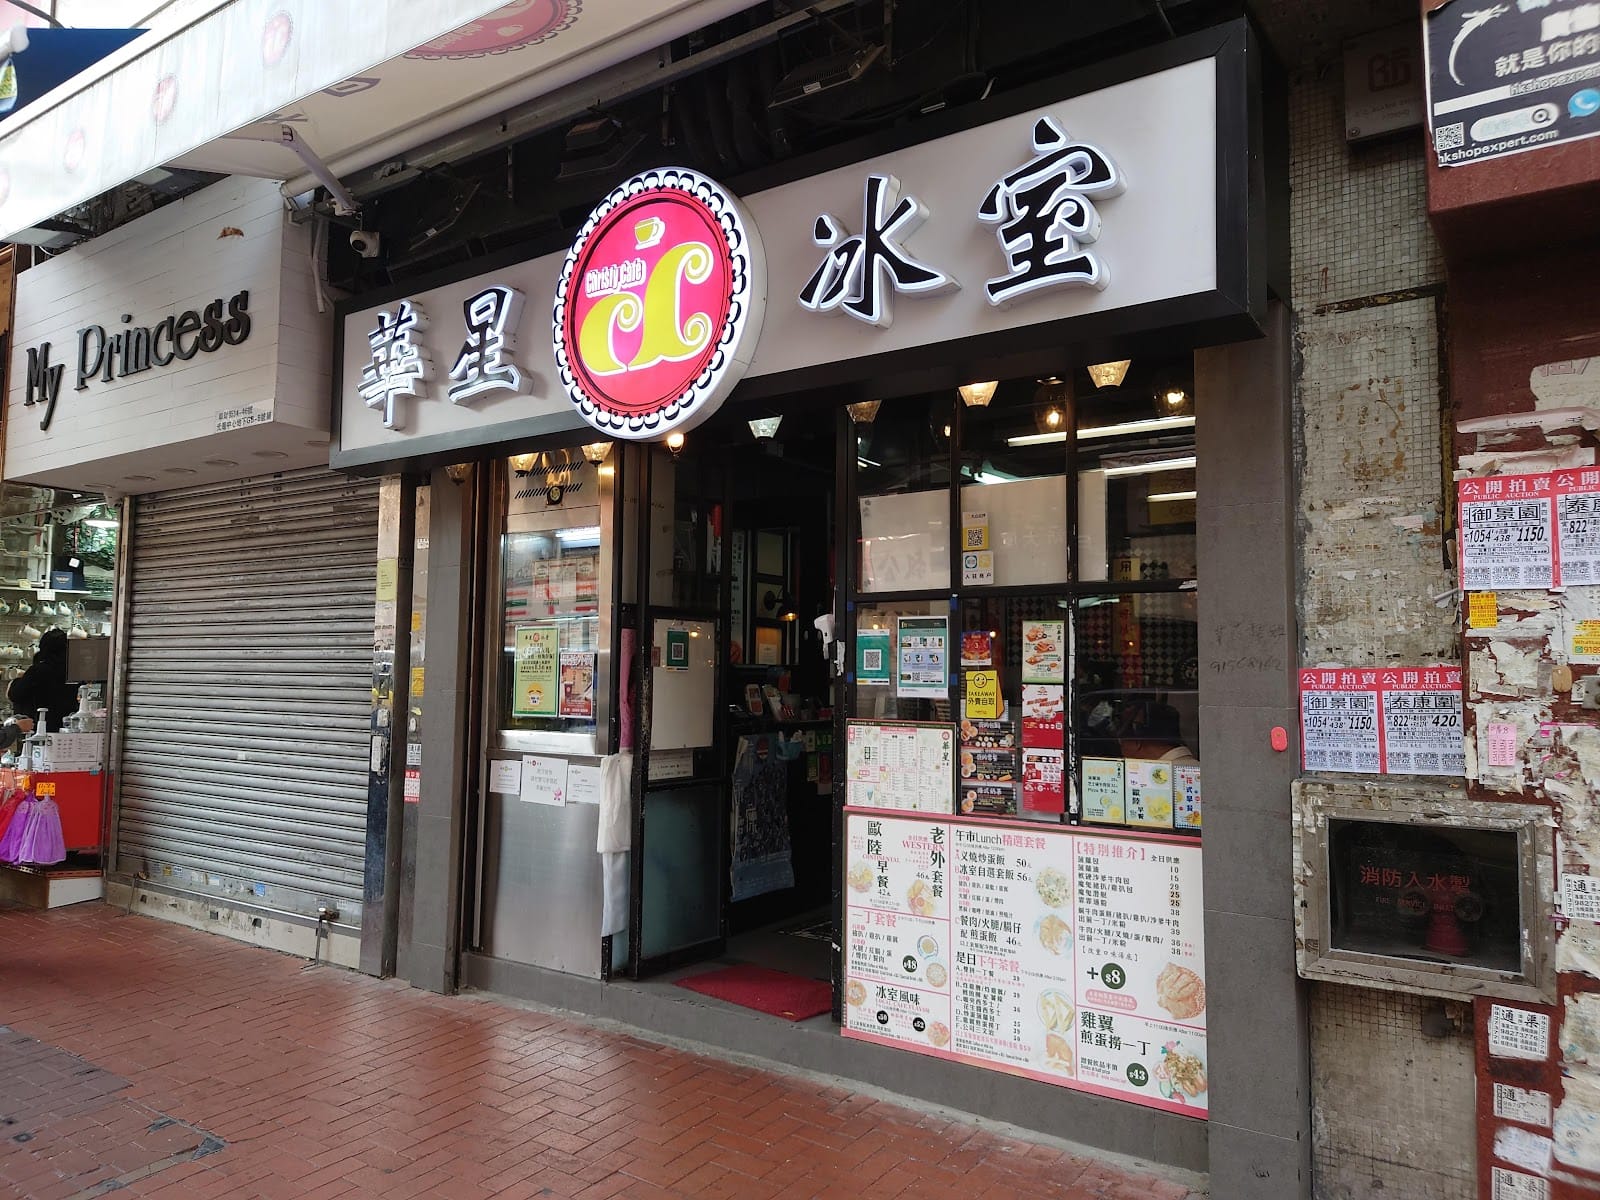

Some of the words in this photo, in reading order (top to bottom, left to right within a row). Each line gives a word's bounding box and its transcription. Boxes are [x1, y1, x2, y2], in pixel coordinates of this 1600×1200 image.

[799, 116, 1122, 324] 冰室
[586, 262, 620, 296] Christy
[24, 342, 64, 431] My
[74, 290, 251, 391] Princess
[357, 286, 532, 429] 華星
[1462, 477, 1551, 495] 公開拍賣
[1471, 506, 1539, 521] 御景園
[1517, 526, 1545, 541] 1150
[1302, 672, 1377, 685] 公開拍賣
[1382, 671, 1462, 685] 公開拍賣
[967, 697, 995, 705] 外賣自取
[1310, 697, 1367, 709] 御景園
[1349, 716, 1372, 730] 1150
[1432, 715, 1457, 727] 420
[902, 840, 945, 852] WESTERN
[1573, 880, 1590, 894] 通
[1170, 899, 1180, 907] 25
[955, 951, 1020, 973] 是日下午茶餐
[1105, 969, 1121, 985] $8
[876, 985, 920, 1006] 冰室風味
[1081, 1011, 1114, 1034] 雞翼
[1080, 1030, 1151, 1056] 煎蛋撈一丁
[1129, 1069, 1146, 1081] $43
